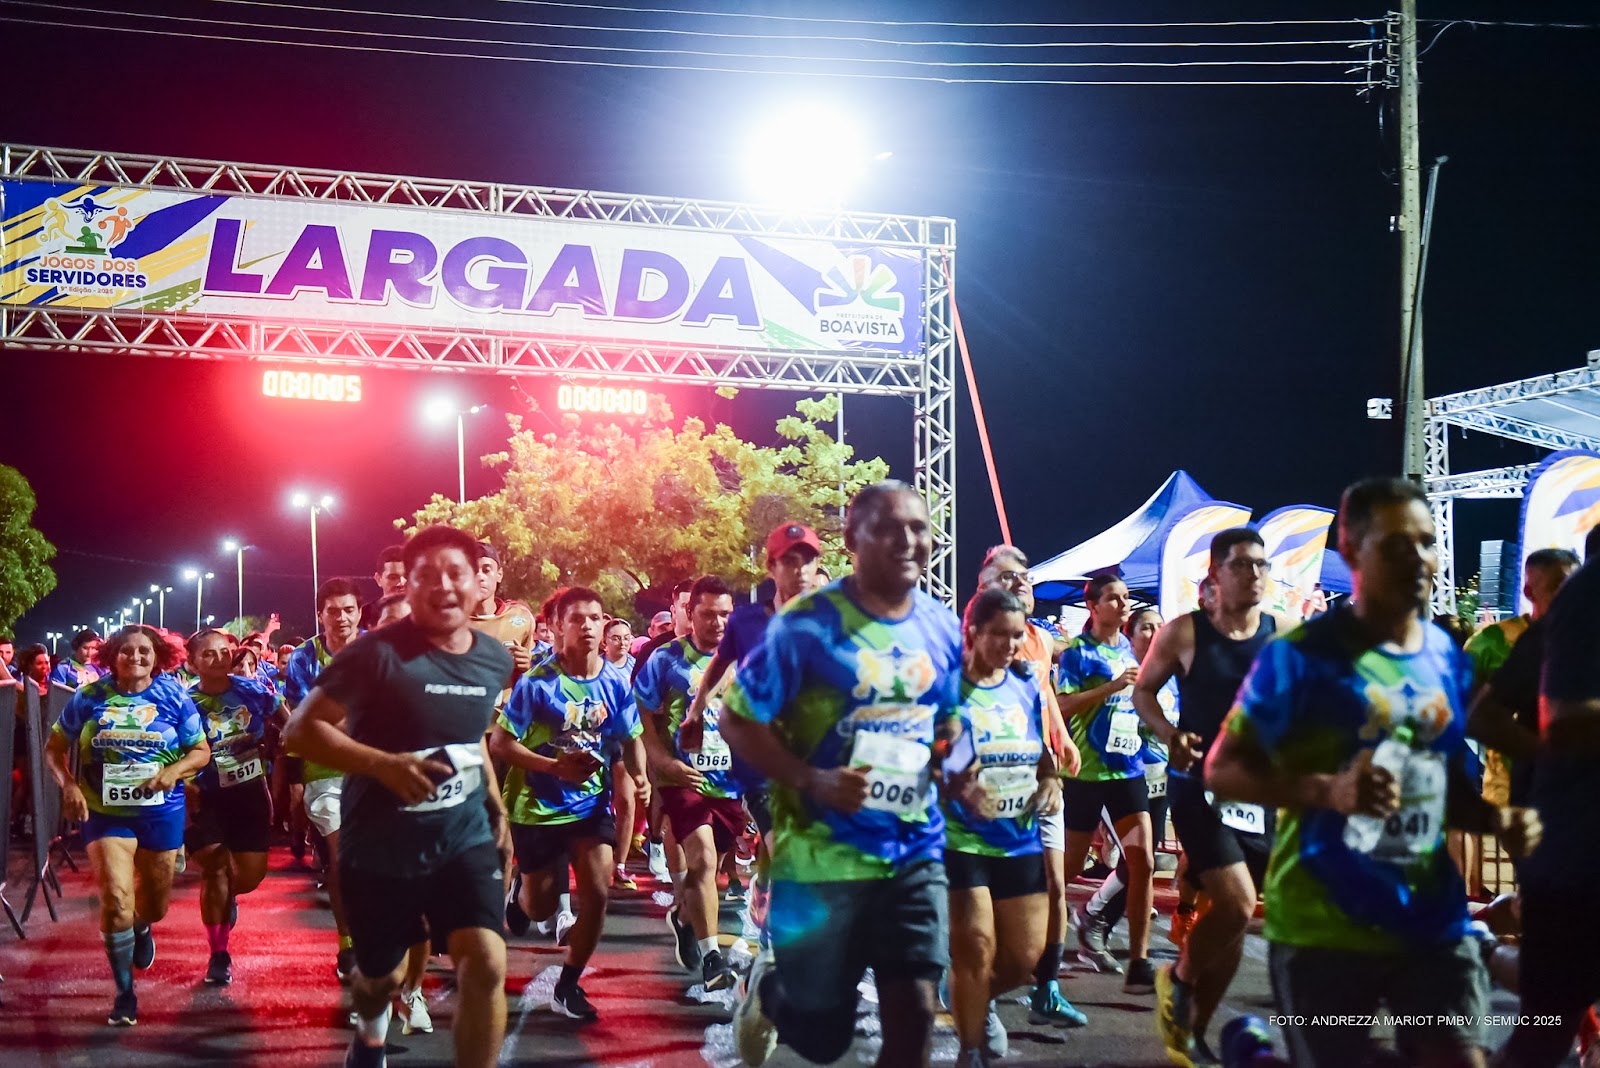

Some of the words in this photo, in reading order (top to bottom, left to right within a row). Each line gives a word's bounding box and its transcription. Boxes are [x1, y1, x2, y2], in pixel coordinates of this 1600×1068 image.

[39, 256, 96, 270] JOGOS
[102, 259, 136, 273] DOS
[202, 217, 763, 328] LARGADA
[26, 268, 147, 289] SERVIDORES
[69, 286, 92, 294] Edição
[92, 738, 166, 750] SERVIDORES
[697, 754, 728, 767] 6165
[871, 781, 916, 806] 006
[1150, 783, 1166, 794] 33
[997, 797, 1024, 812] 014
[1386, 812, 1429, 837] 041
